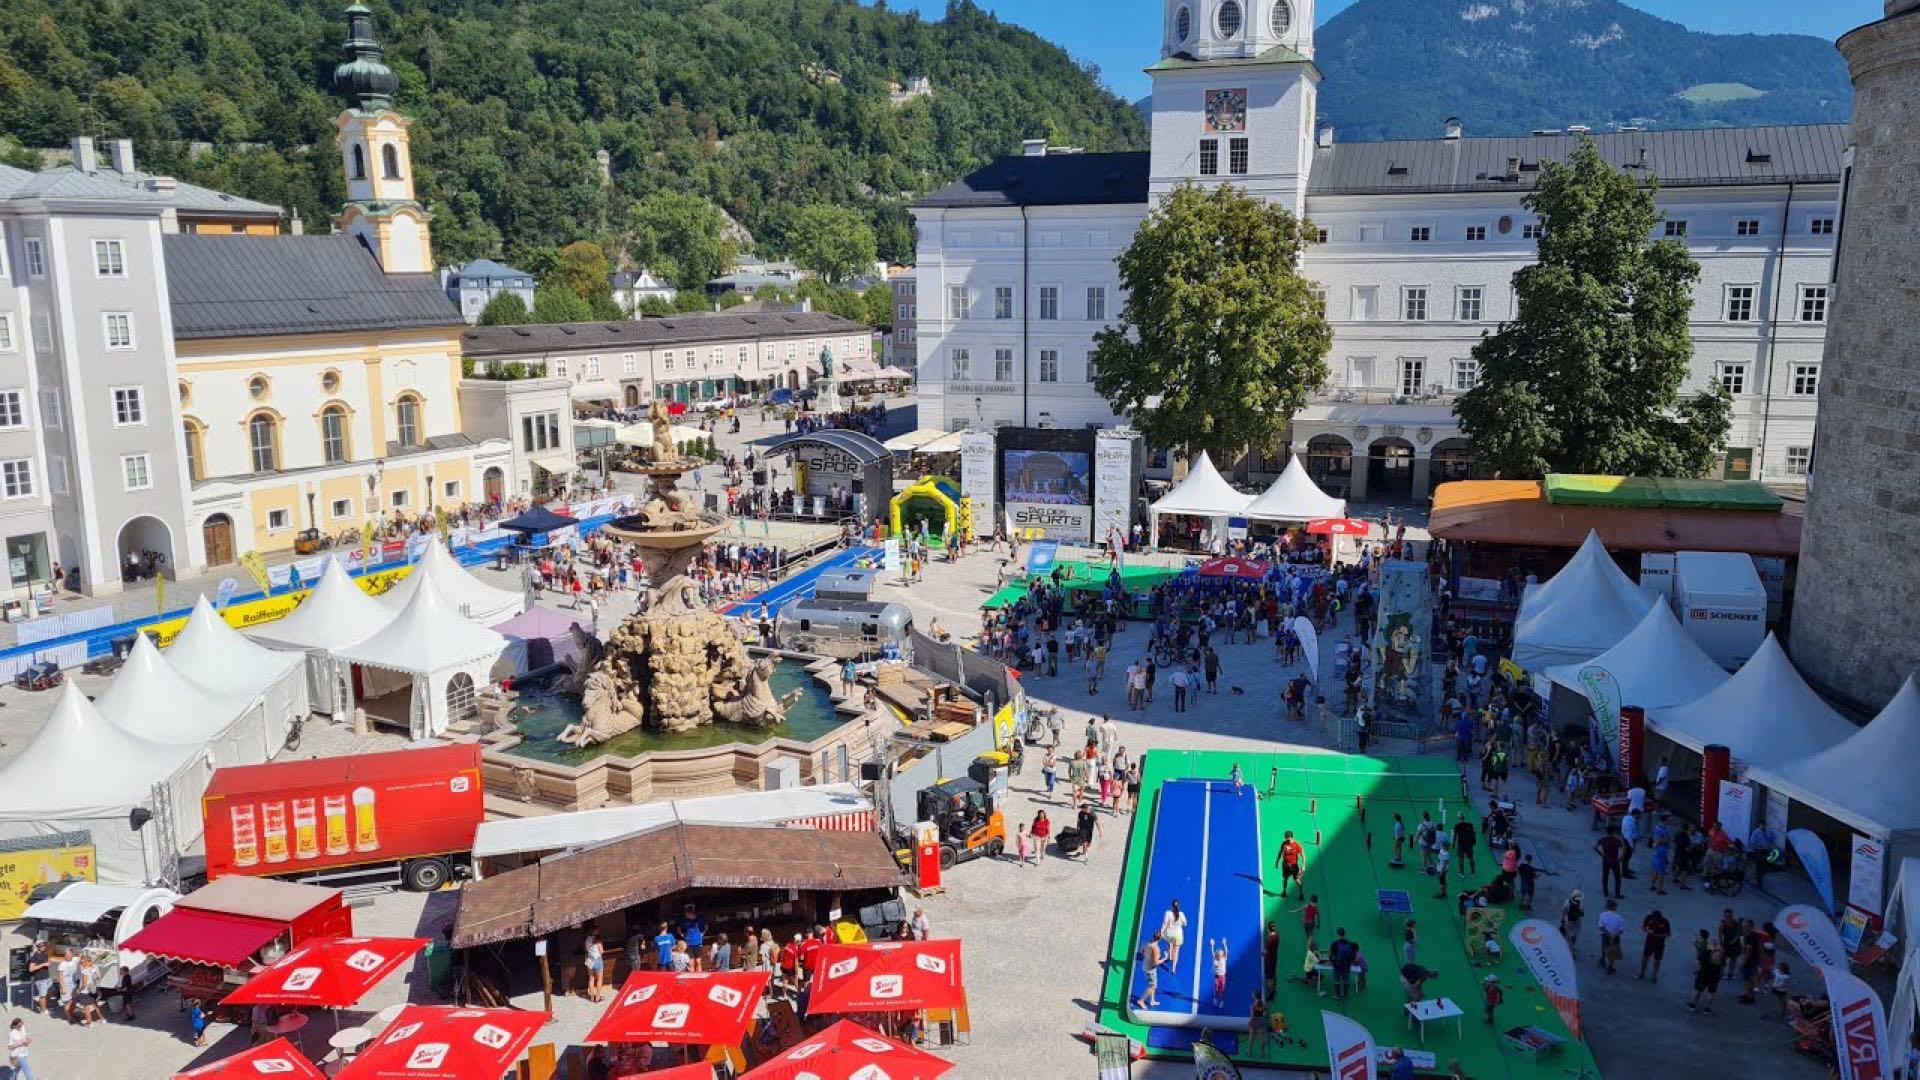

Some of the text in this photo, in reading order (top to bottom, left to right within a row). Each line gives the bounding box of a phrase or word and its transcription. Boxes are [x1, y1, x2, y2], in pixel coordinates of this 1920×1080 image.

[1015, 511, 1082, 526] SPORTS
[242, 606, 291, 624] Raiffeisen
[1710, 611, 1759, 621] SCHENKER
